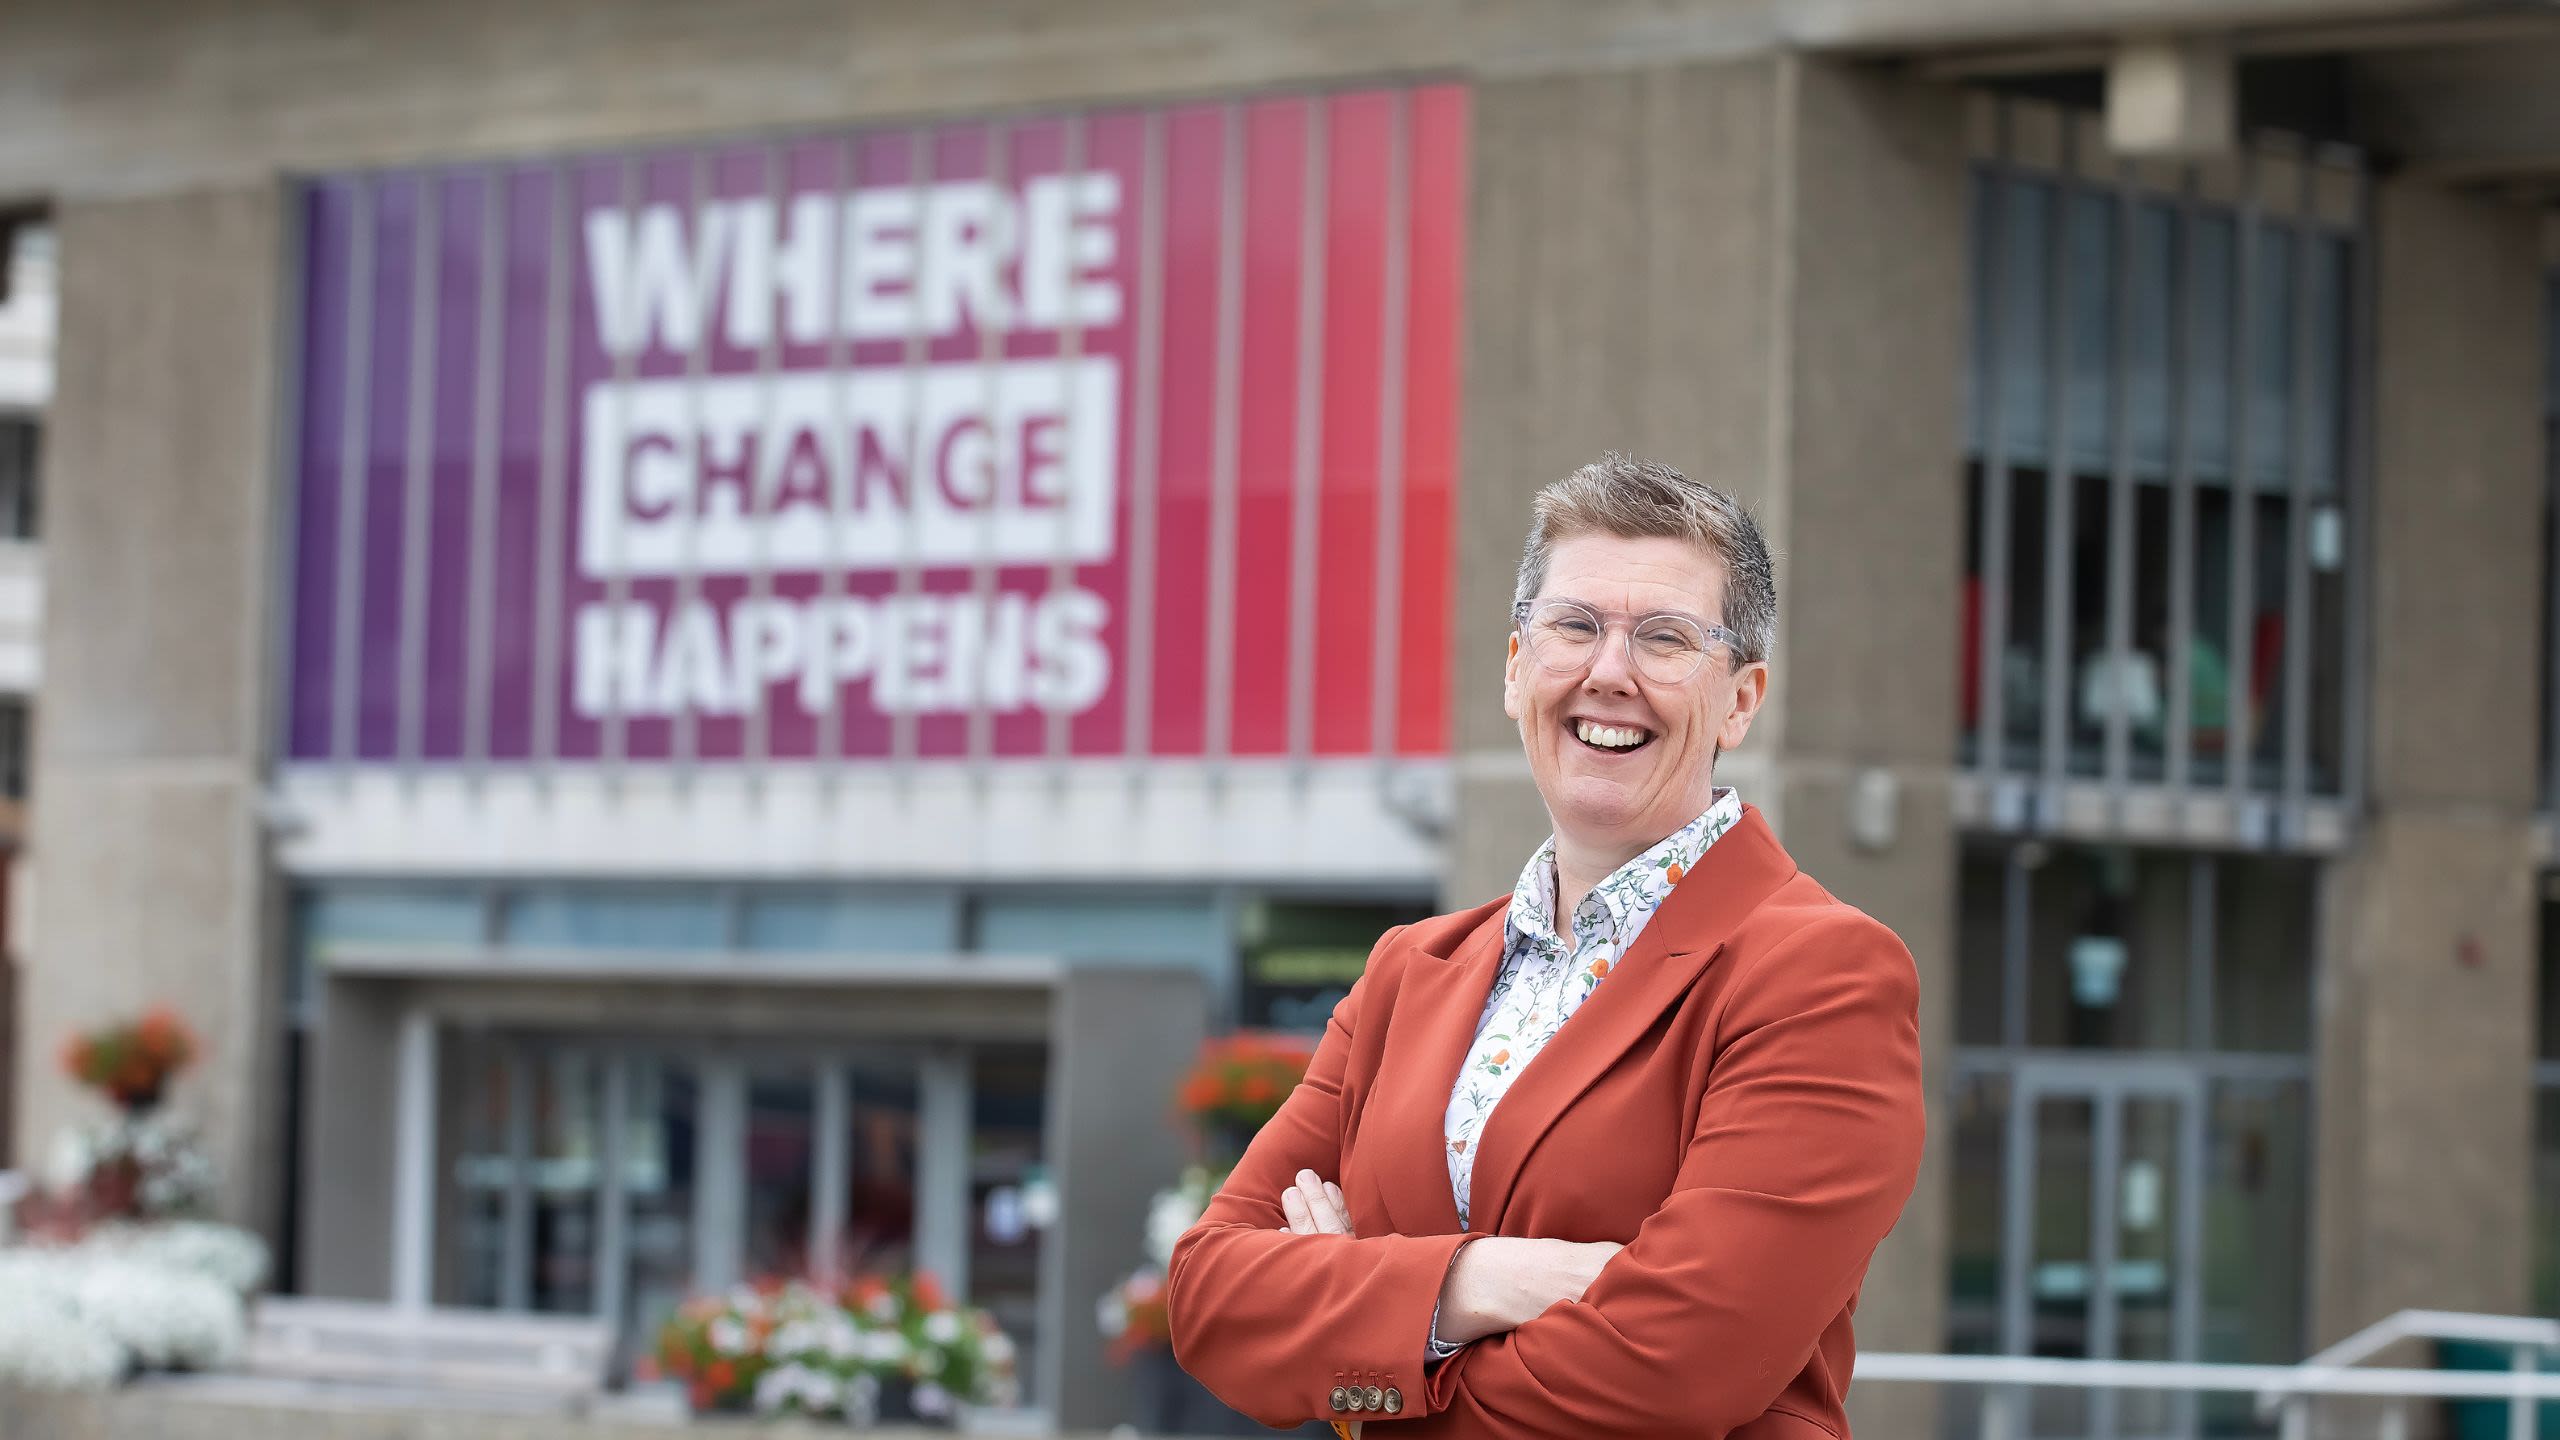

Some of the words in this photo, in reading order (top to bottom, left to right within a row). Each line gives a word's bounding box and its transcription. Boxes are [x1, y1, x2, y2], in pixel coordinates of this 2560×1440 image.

[585, 172, 1122, 354] WHERE
[624, 416, 1067, 522] CHANGE
[574, 587, 1111, 718] HAPPENS
